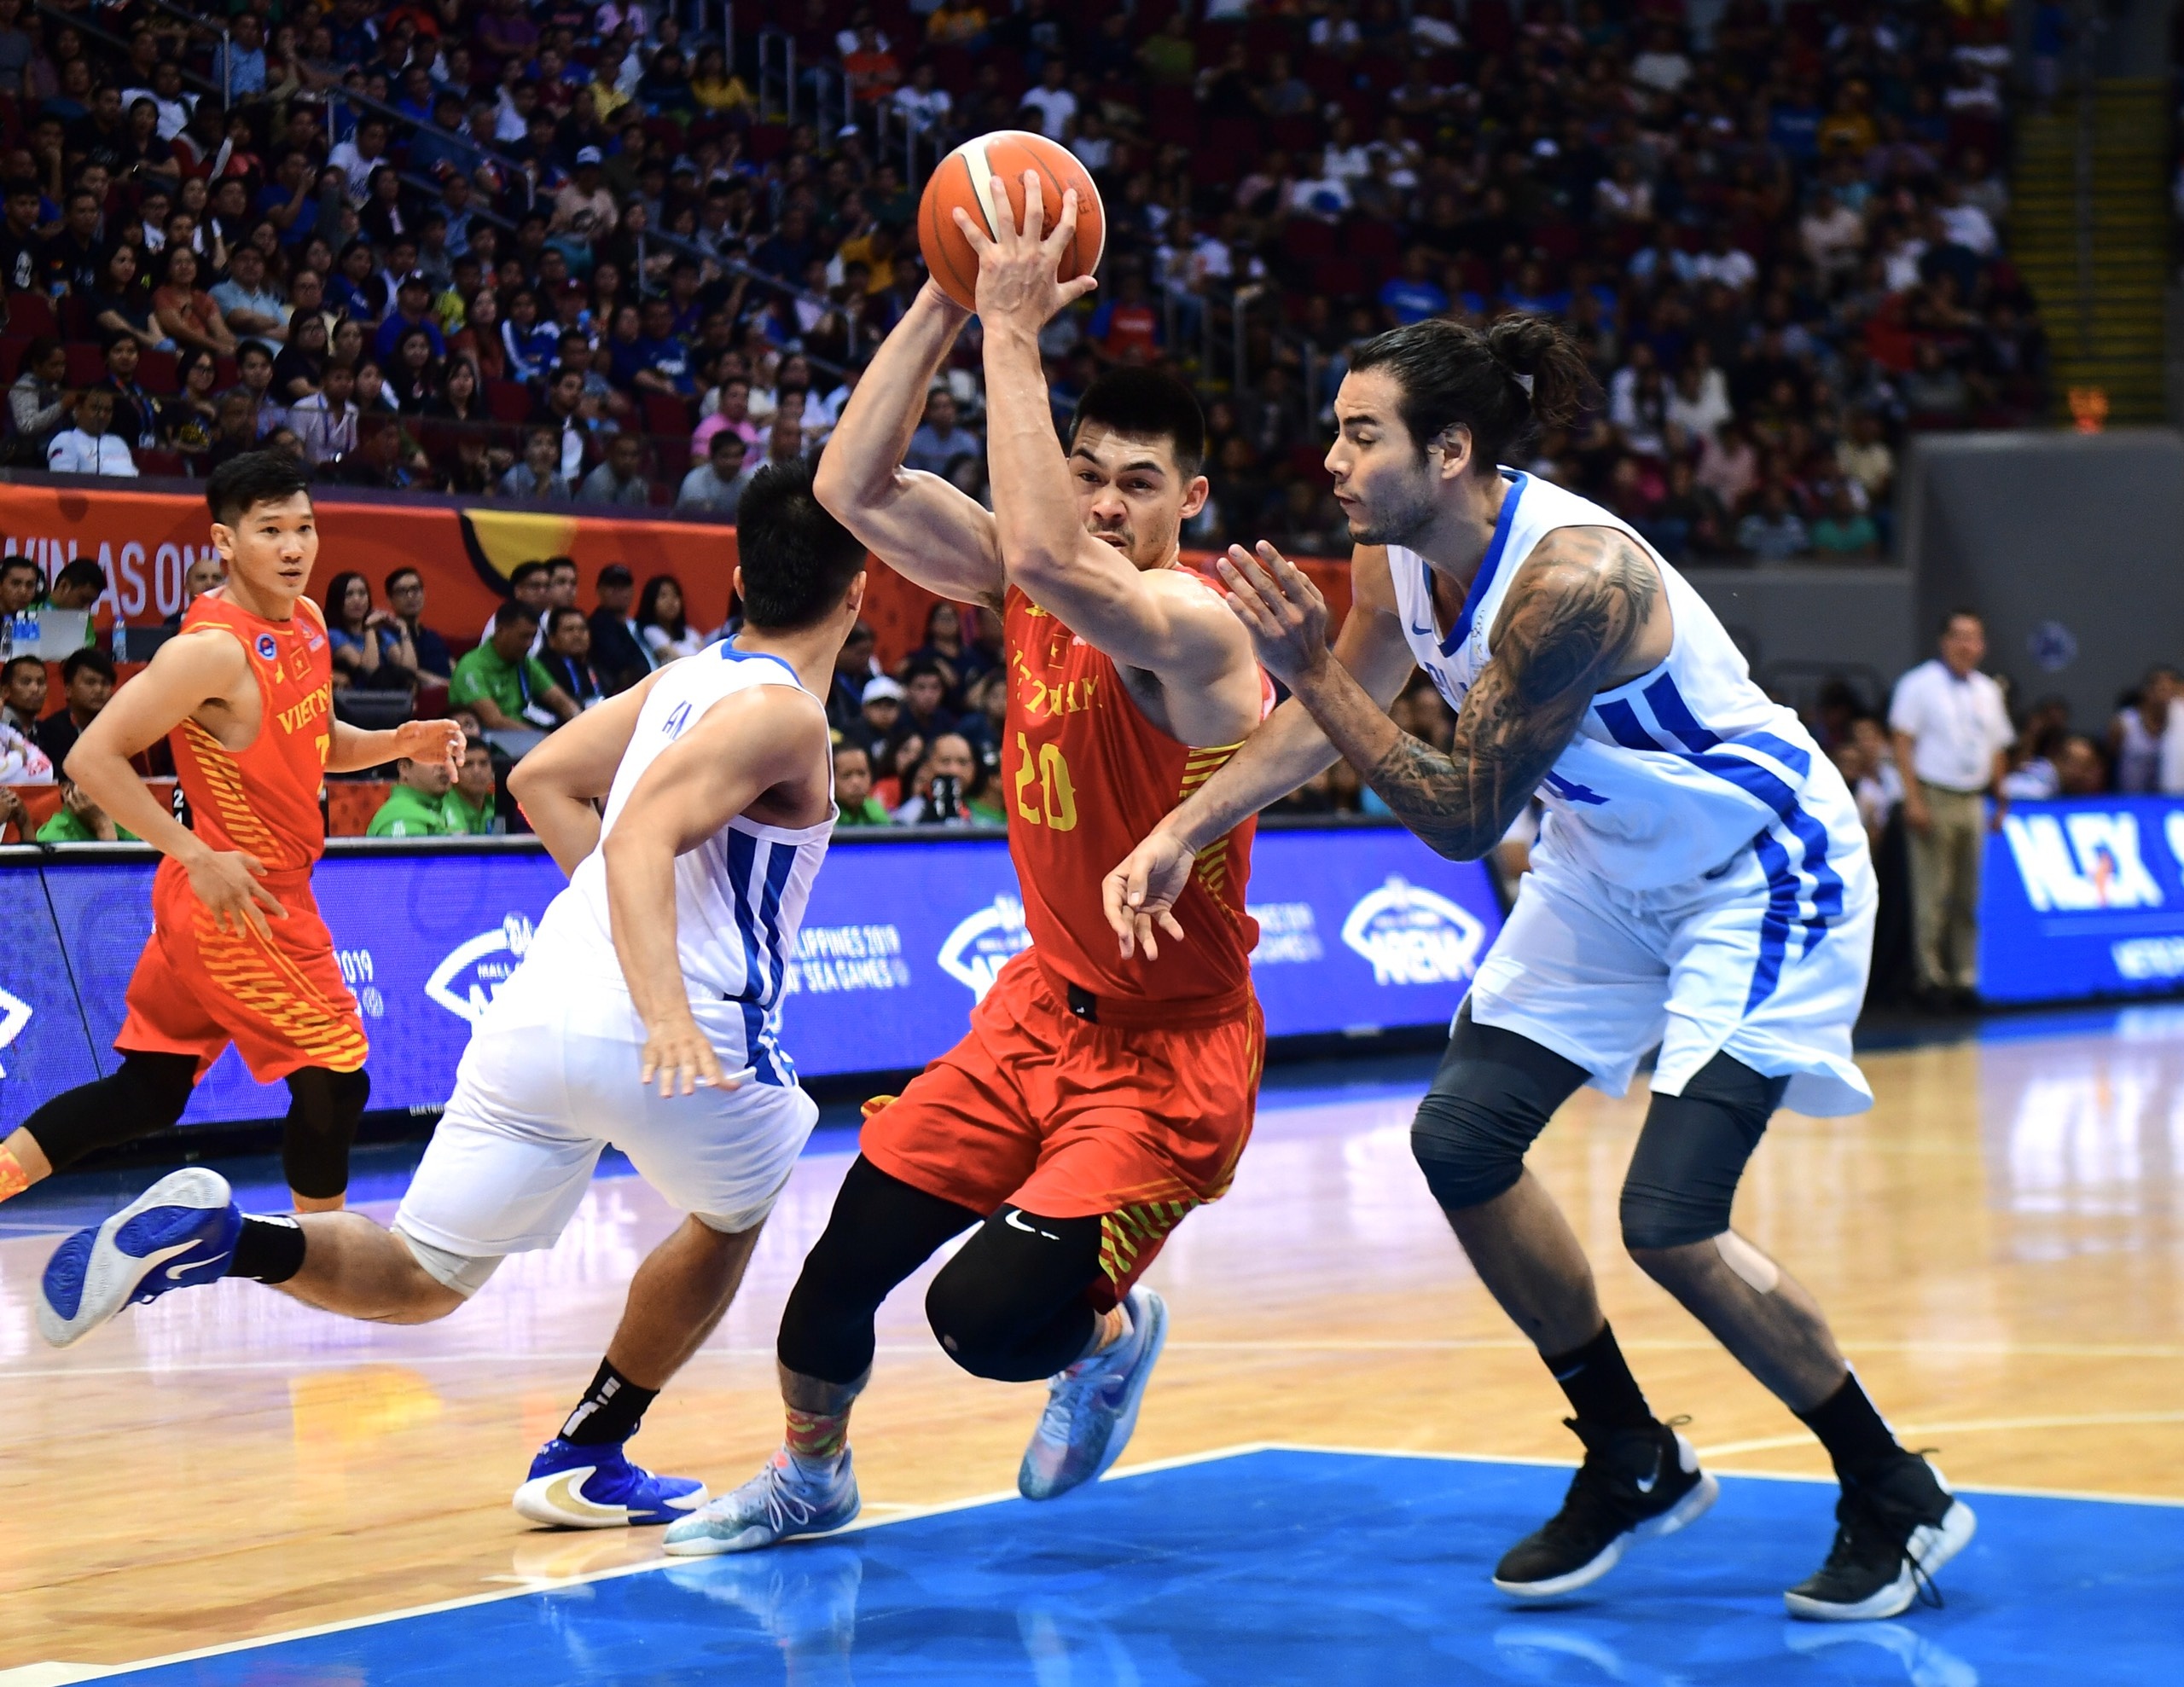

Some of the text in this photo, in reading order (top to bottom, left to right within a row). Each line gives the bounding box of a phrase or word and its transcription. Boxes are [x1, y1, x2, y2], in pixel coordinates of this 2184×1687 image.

[90, 541, 145, 616] AS
[173, 789, 183, 808] 2
[1015, 732, 1076, 832] 20
